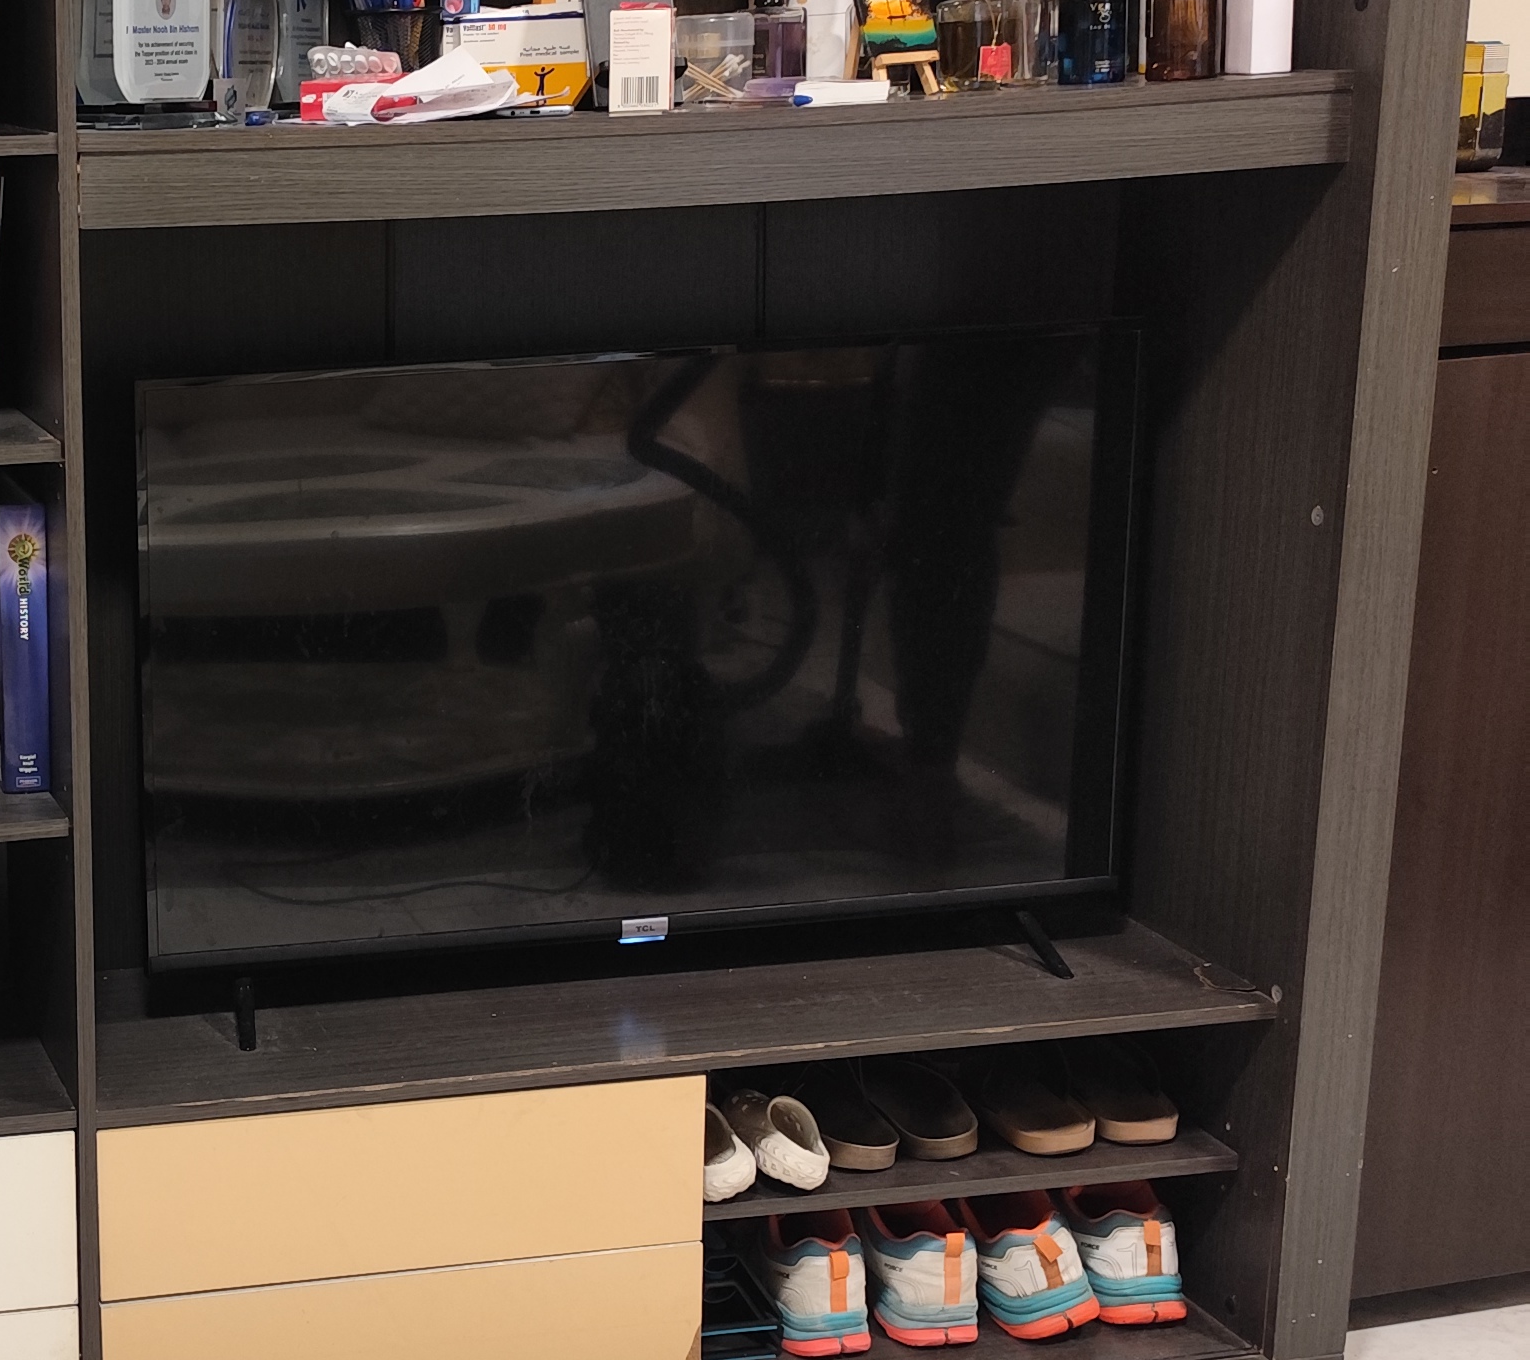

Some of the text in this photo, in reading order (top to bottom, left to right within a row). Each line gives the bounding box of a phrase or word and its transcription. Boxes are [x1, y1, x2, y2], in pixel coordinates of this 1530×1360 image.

[132, 25, 152, 34] Master
[153, 25, 168, 34] Nooh
[179, 25, 199, 33] Hisham
[16, 556, 32, 641] World HISTORY
[635, 924, 656, 932] TCL
[1080, 1241, 1100, 1251] FORCE
